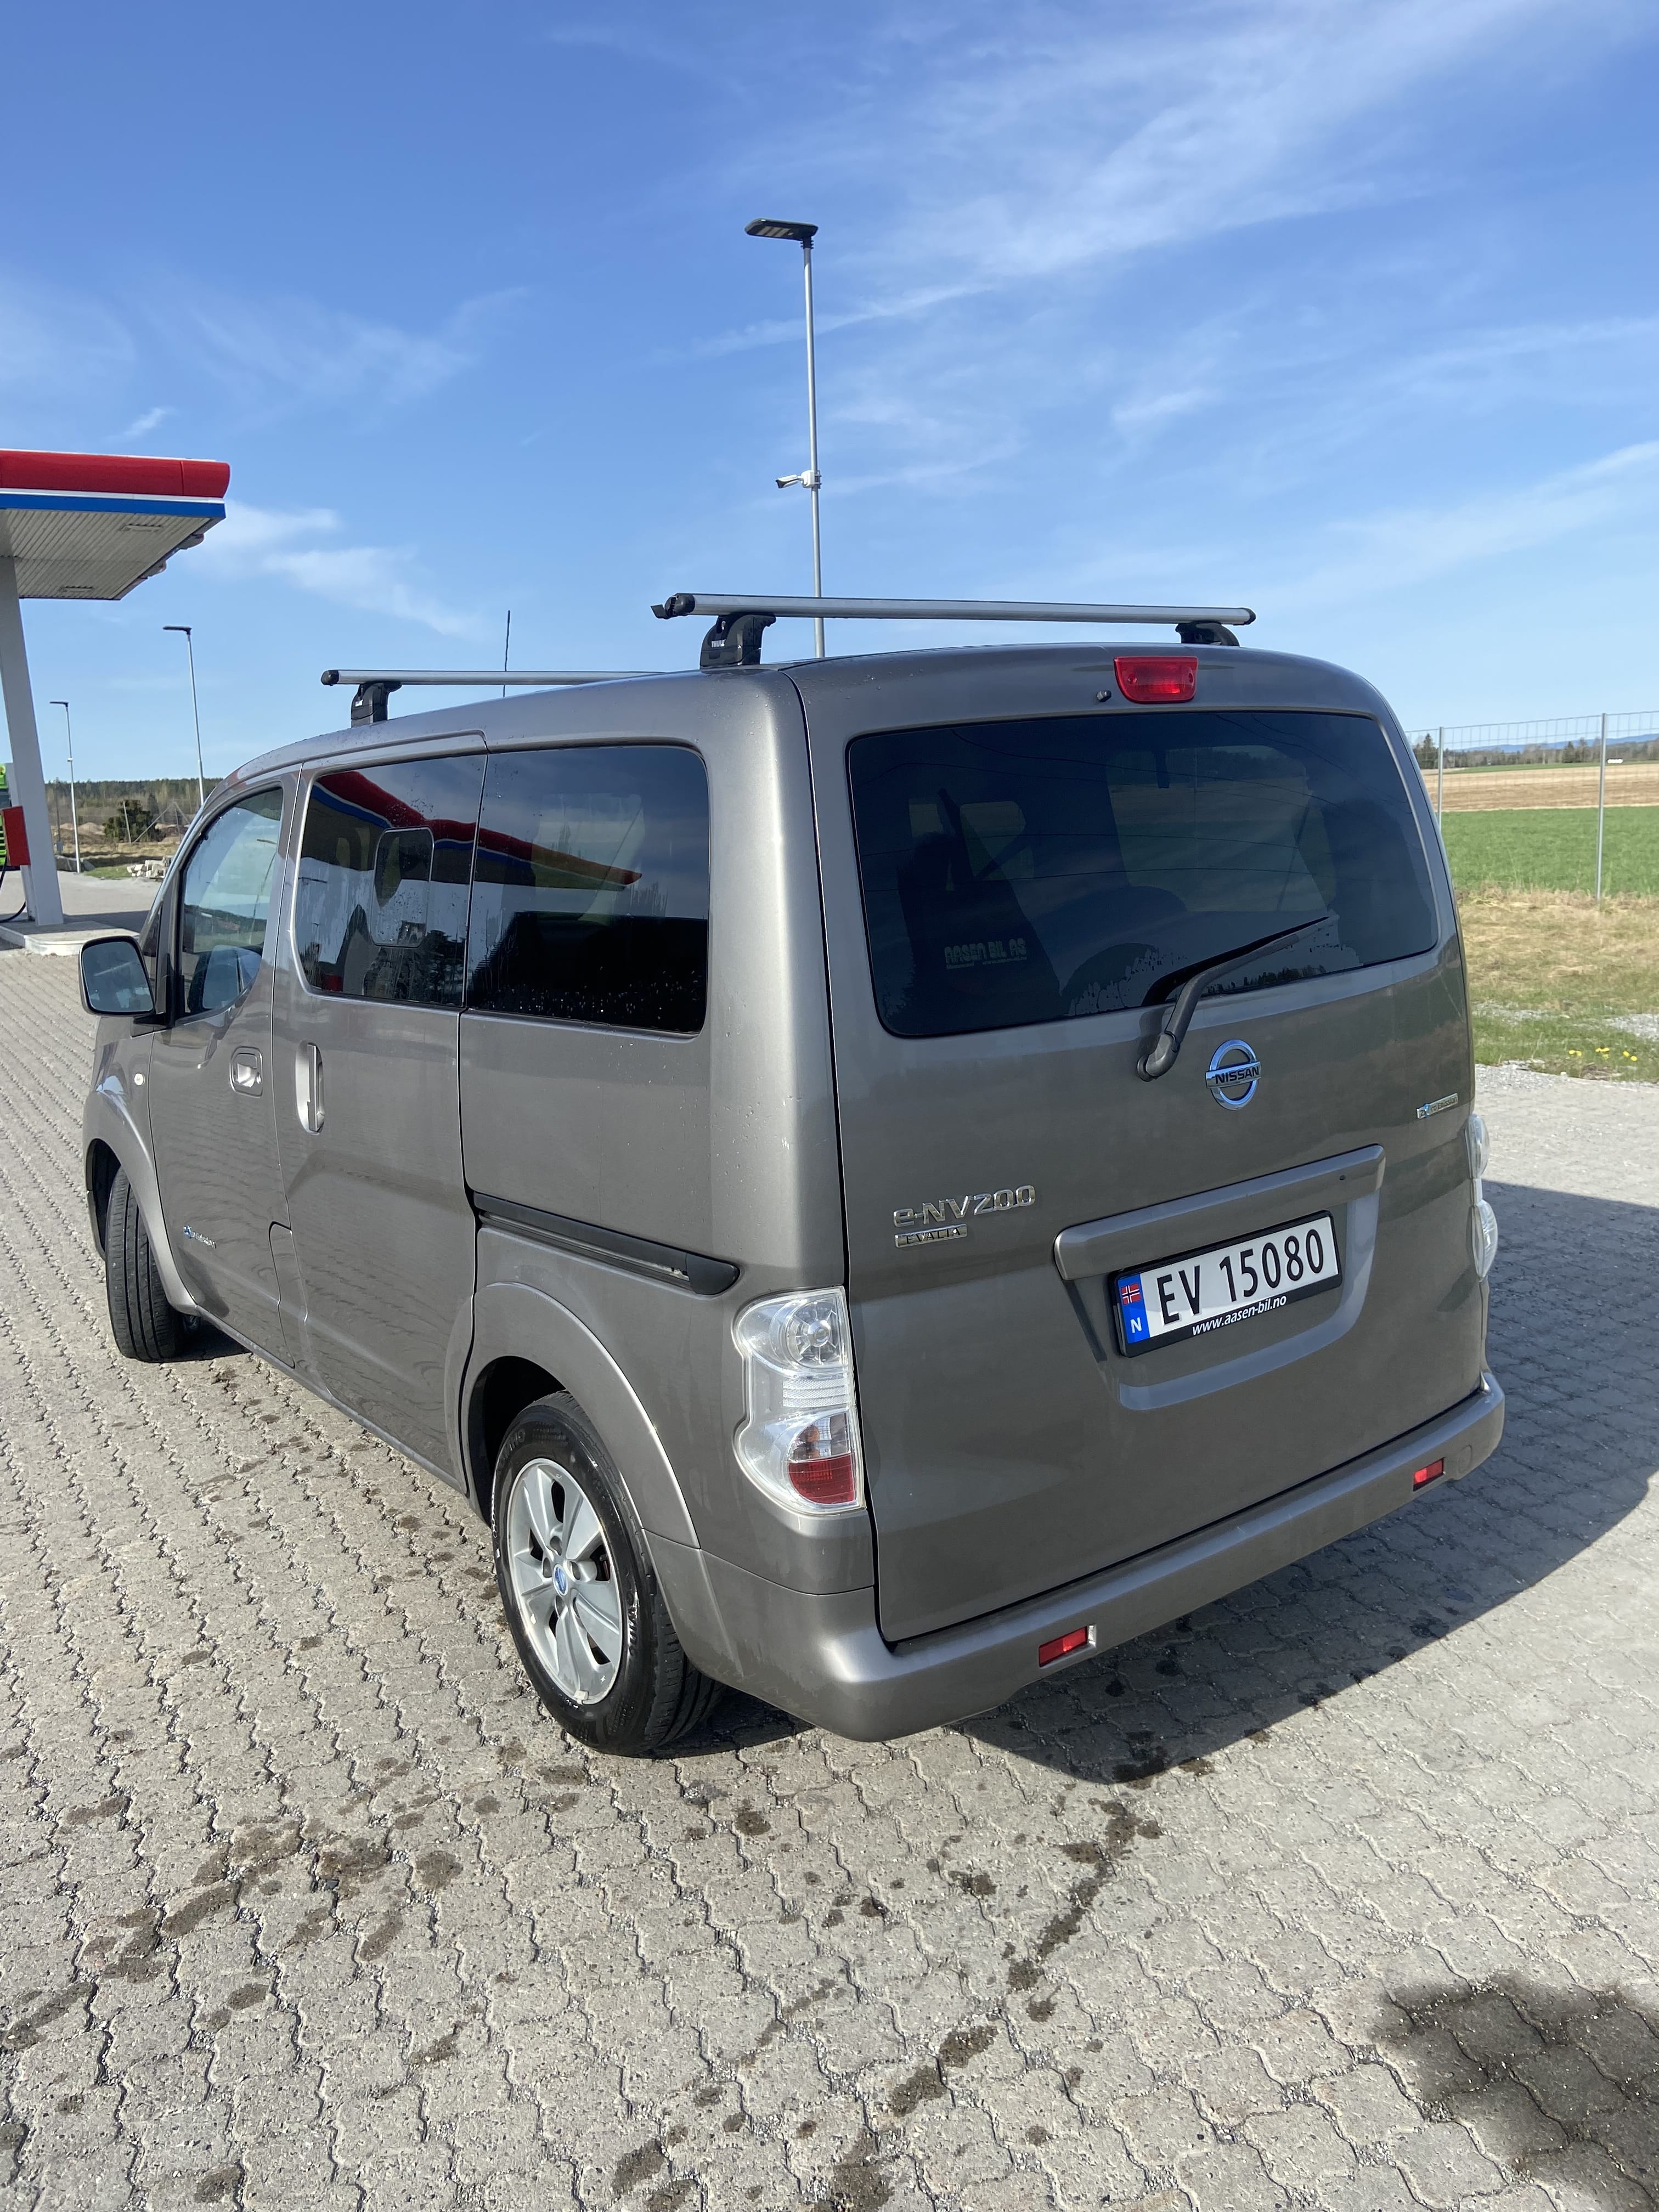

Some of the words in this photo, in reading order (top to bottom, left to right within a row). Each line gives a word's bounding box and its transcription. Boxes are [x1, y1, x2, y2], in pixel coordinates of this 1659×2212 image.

[712, 639, 725, 648] THULE
[1009, 937, 1028, 956] AS
[1215, 1065, 1260, 1084] NISSAN
[893, 1184, 1036, 1227] e-NV200
[906, 1228, 961, 1244] EVALIA
[1156, 1265, 1202, 1326] EV
[1219, 1228, 1324, 1302] 15080
[1192, 1295, 1287, 1336] www.aasen-bil.no
[1130, 1317, 1142, 1334] N
